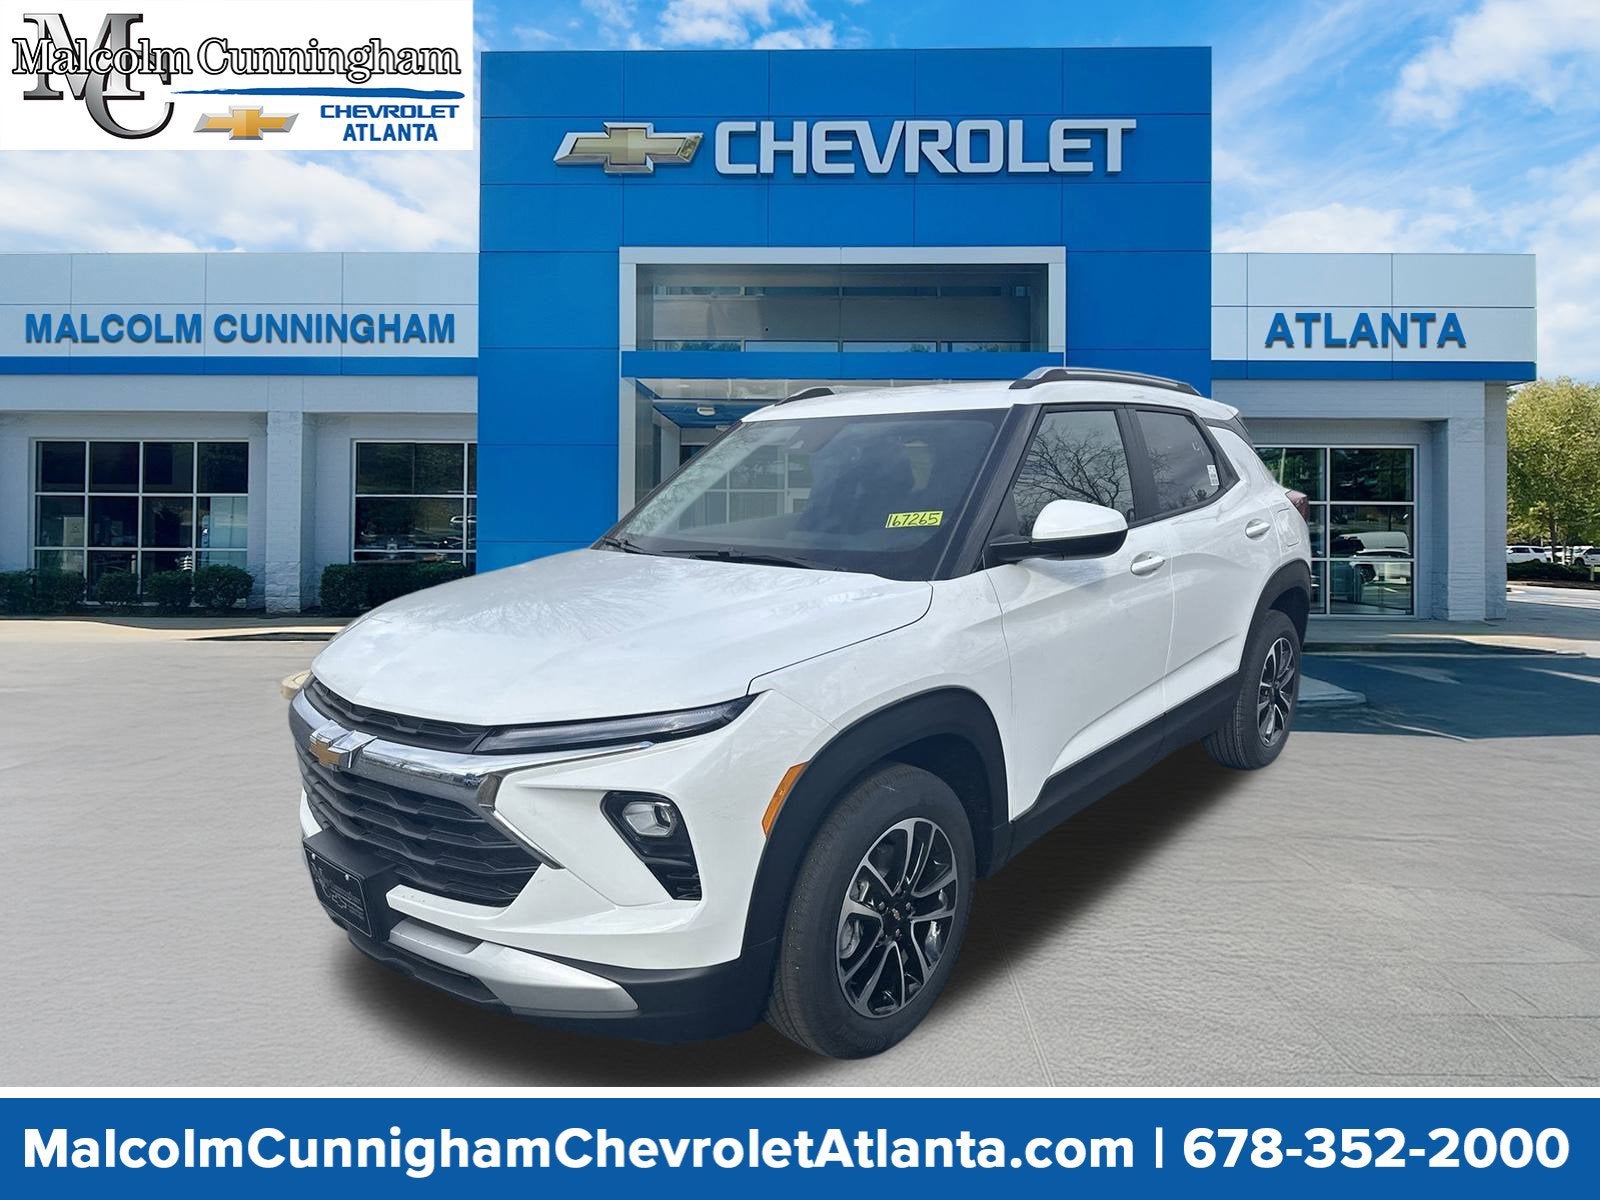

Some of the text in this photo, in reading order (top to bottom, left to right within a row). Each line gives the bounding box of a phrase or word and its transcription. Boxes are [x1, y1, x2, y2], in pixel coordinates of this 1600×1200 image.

[715, 119, 1137, 175] CHEVROLET
[25, 313, 456, 344] MALCOLM CUNNINGHAM
[1265, 312, 1467, 348] ATLANTA
[886, 512, 941, 527] 167265
